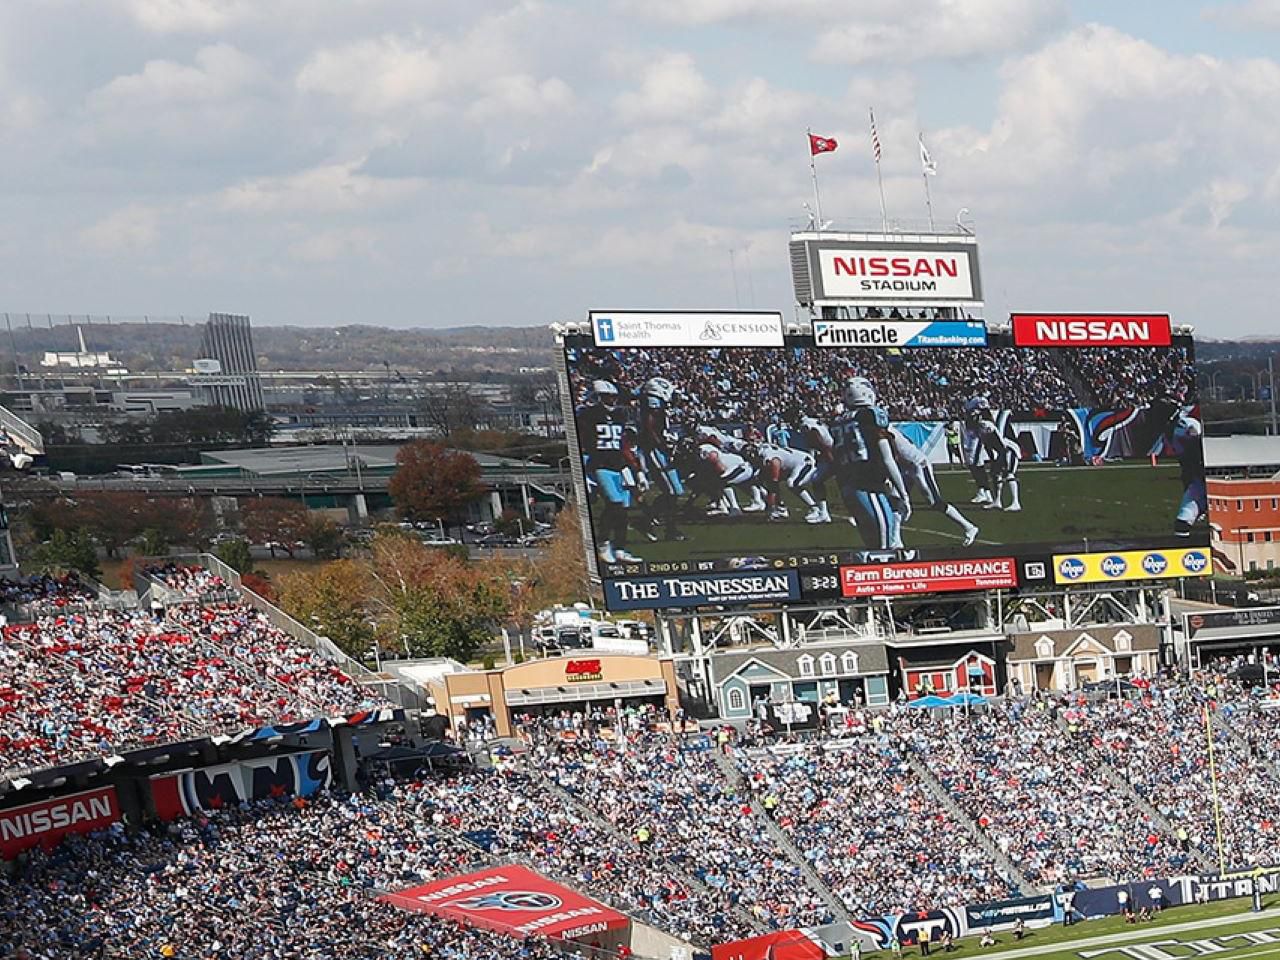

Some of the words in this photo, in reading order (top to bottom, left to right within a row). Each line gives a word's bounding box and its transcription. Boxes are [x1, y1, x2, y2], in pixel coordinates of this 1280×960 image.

[833, 257, 958, 278] NISSAN
[860, 280, 937, 291] STADIUM
[617, 321, 641, 331] Saint
[644, 322, 681, 331] Thomas
[706, 321, 778, 335] ASCENSION
[1036, 321, 1150, 341] NISSAN
[618, 330, 652, 339] Health
[817, 325, 898, 344] Pinnacle
[918, 335, 985, 345] TitansBanking.com
[650, 562, 670, 572] 2ND
[789, 557, 798, 567] 3
[829, 555, 838, 565] 3
[1144, 558, 1167, 574] Kroger
[1185, 556, 1208, 571] Kroger
[626, 564, 640, 574] 22
[846, 569, 880, 582] Farm
[883, 567, 928, 580] Bureau
[930, 562, 1009, 577] INSURANCE
[1061, 563, 1084, 578] Kroger
[1103, 561, 1126, 576] Kroger
[614, 581, 660, 600] THE
[663, 576, 790, 598] TENNESSEAN
[811, 577, 838, 590] 3:23
[856, 584, 874, 593] Auto
[883, 583, 905, 592] Home
[912, 582, 927, 590] Life
[976, 577, 1013, 586] Tennessee
[0, 796, 112, 841] NISSAN
[417, 875, 509, 902] NISSAN
[514, 907, 603, 933] NISSAN
[561, 922, 608, 940] NISSAN
